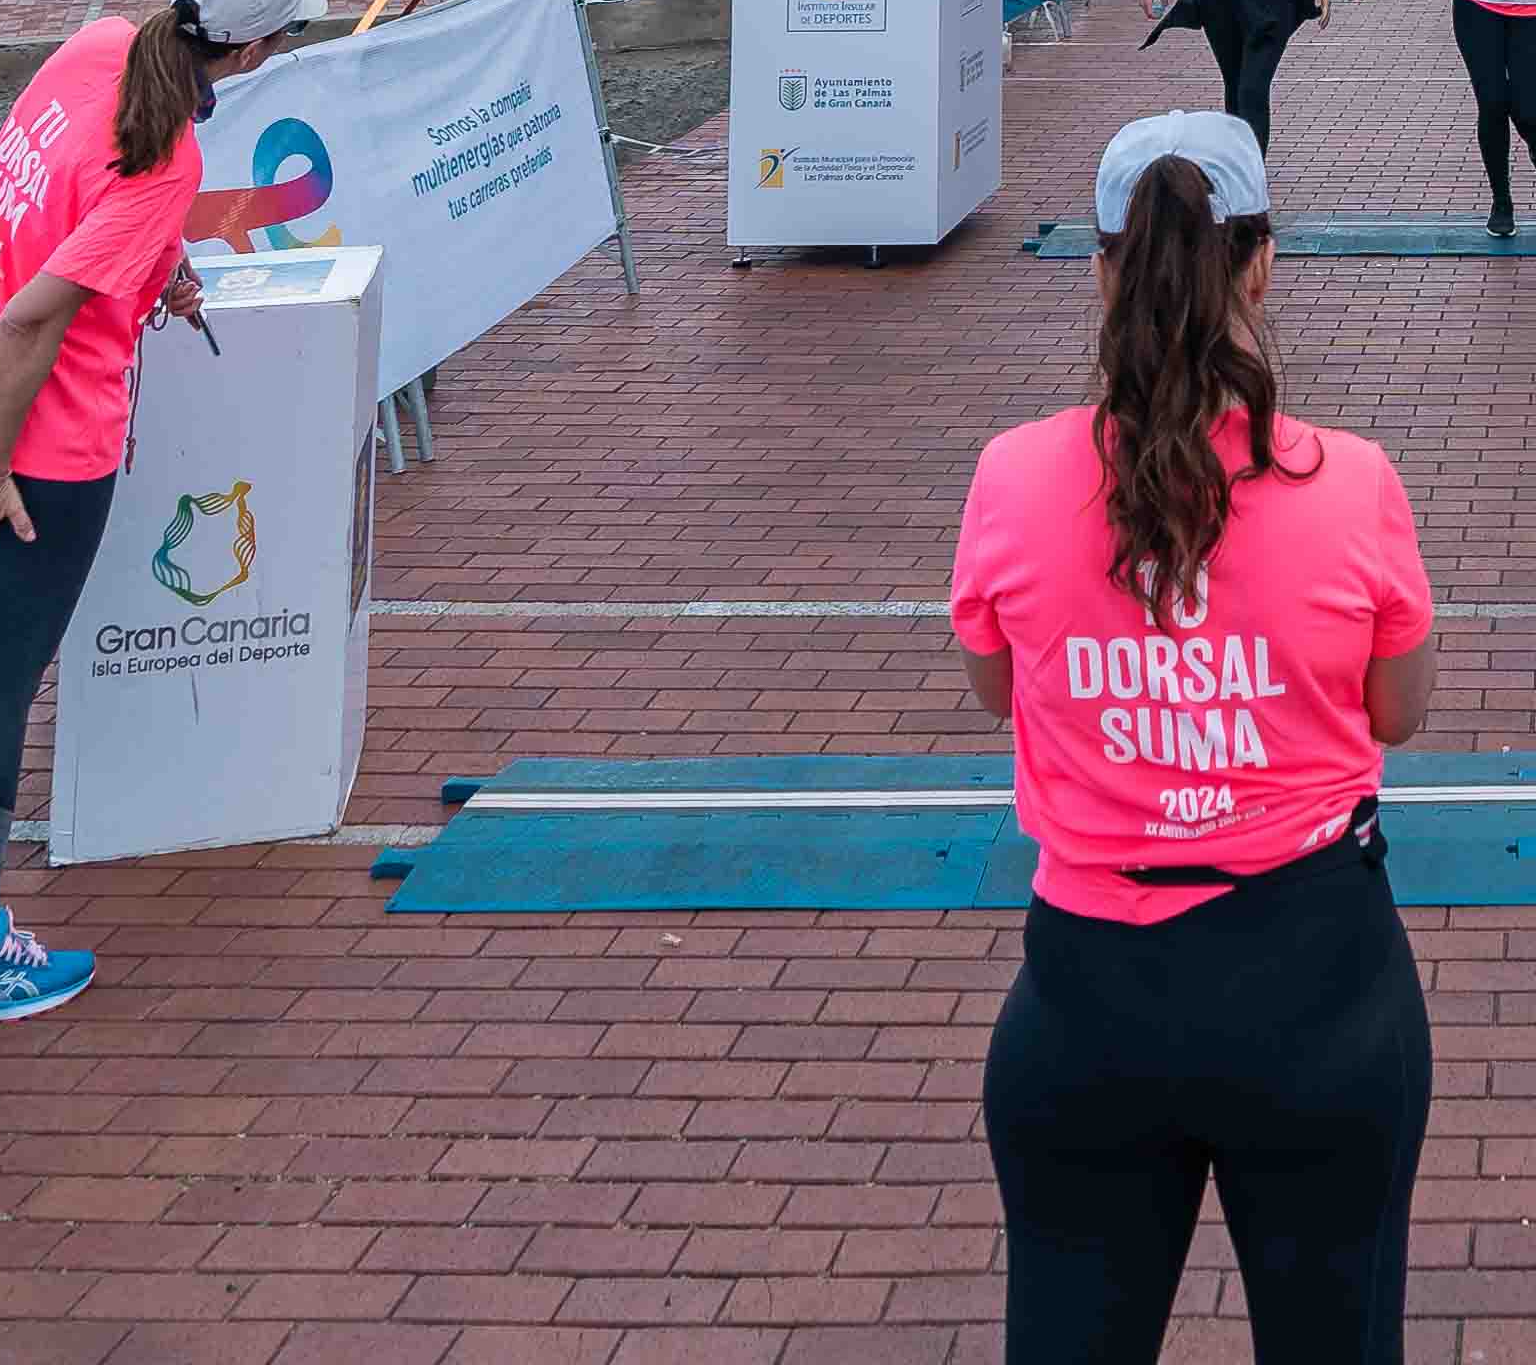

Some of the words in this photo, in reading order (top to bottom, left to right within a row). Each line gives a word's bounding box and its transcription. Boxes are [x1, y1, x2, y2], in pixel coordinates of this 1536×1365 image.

[814, 13, 872, 25] DEPORTES
[814, 77, 893, 89] Ayuntamiento
[814, 87, 829, 98] de
[833, 88, 850, 98] Las
[855, 87, 893, 98] Palmas
[814, 99, 826, 109] de
[828, 99, 853, 109] Gran
[854, 97, 892, 109] Canaria
[30, 98, 70, 149] TU
[427, 112, 475, 147] Somos
[478, 106, 488, 127] la
[412, 133, 506, 198] multienergías
[507, 126, 524, 153] que
[448, 196, 469, 221] tus
[469, 175, 510, 208] carreras
[95, 624, 176, 655] Gran
[180, 608, 311, 646] Canaria
[92, 658, 121, 678] Isla
[127, 653, 202, 677] Europea
[206, 649, 233, 665] del
[239, 641, 311, 664] Deporte
[1066, 635, 1285, 706] DORSAL
[1102, 707, 1270, 772] SUMA
[1159, 783, 1235, 822] 2024
[1144, 821, 1158, 837] XX
